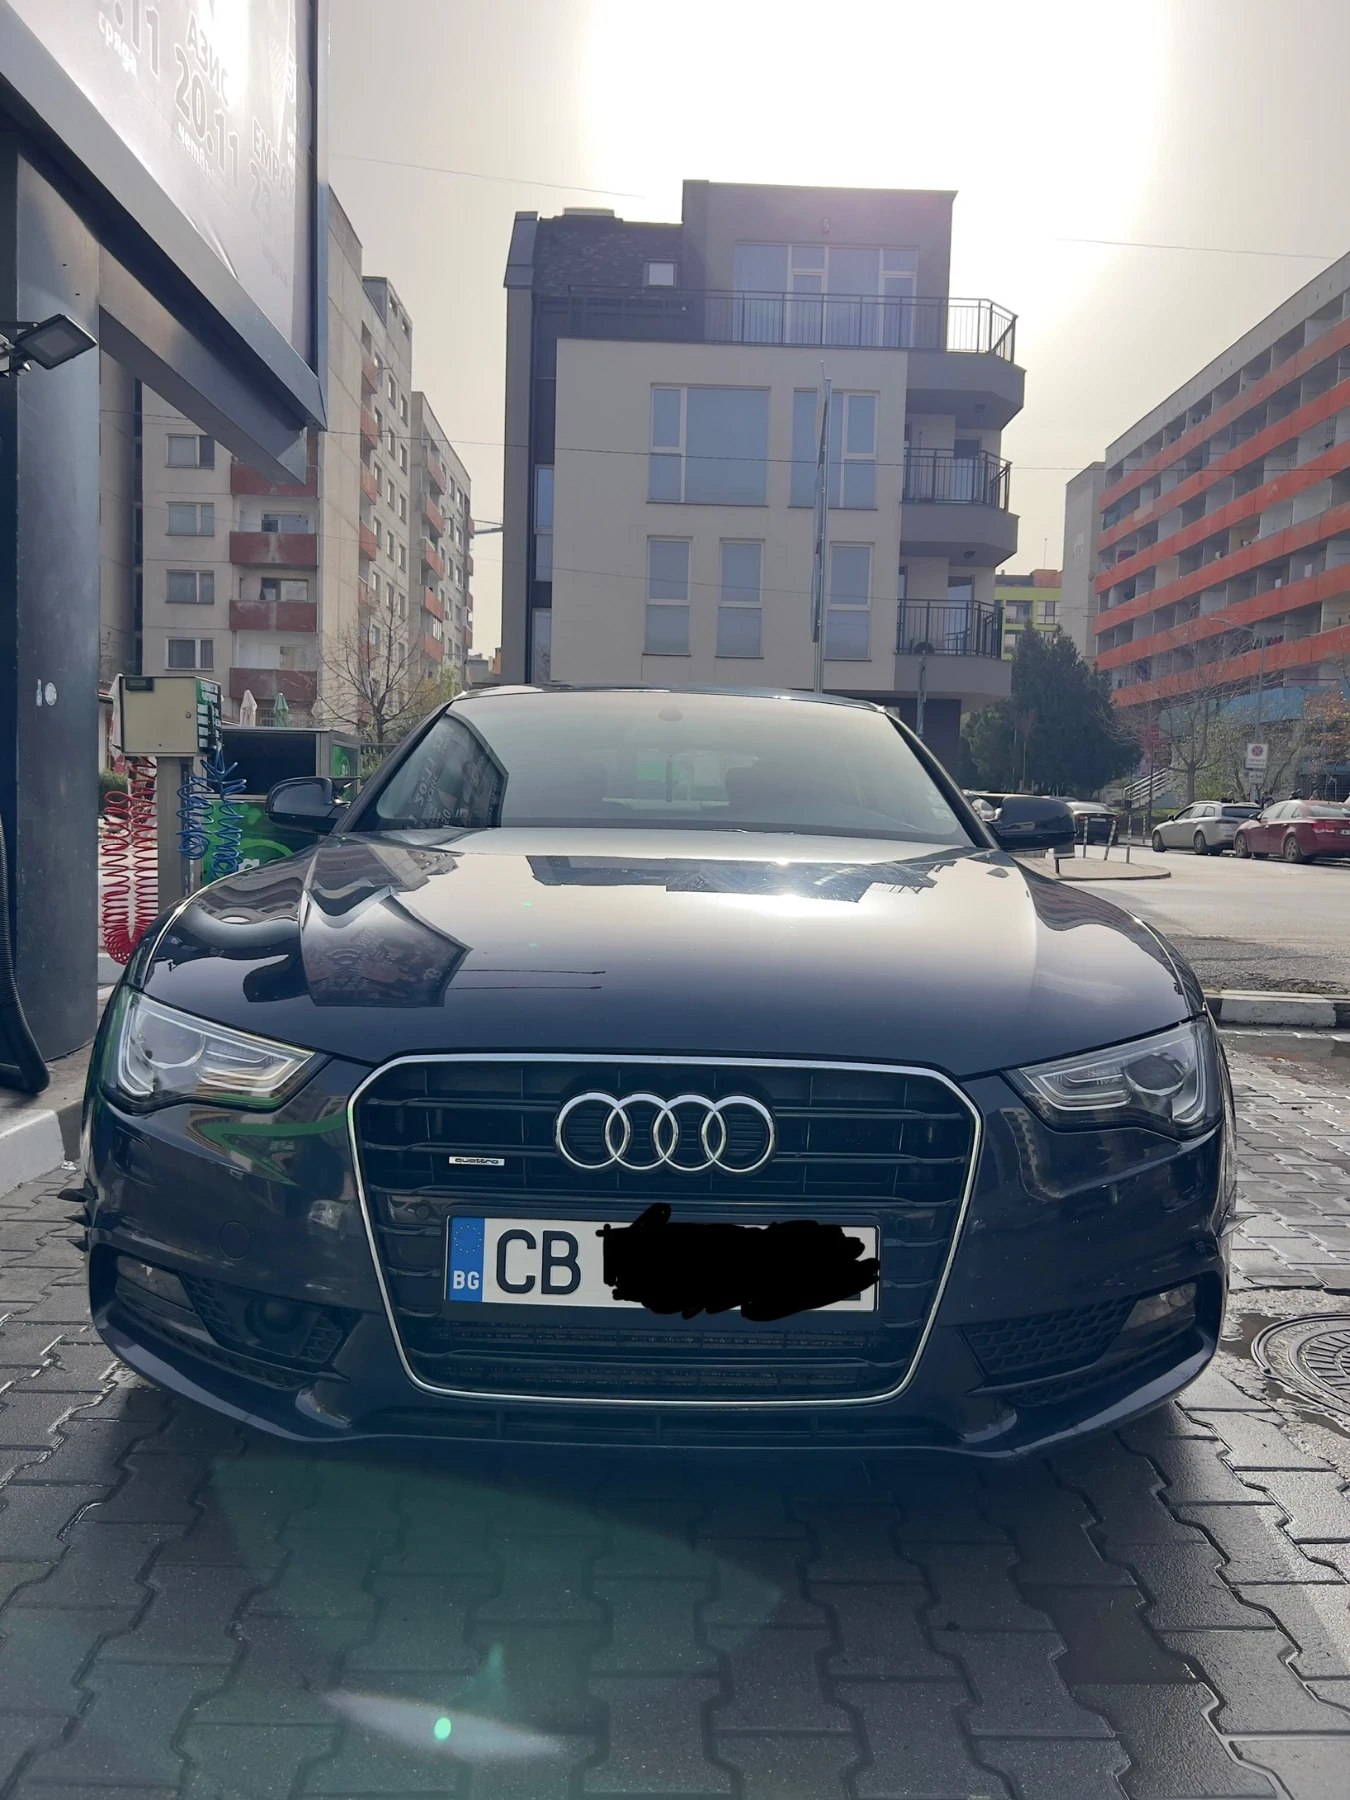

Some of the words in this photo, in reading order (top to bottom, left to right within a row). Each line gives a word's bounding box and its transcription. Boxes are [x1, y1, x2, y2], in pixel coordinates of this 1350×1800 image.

[173, 43, 239, 193] 20.11
[453, 1270, 480, 1290] BG
[496, 1229, 581, 1295] CB
